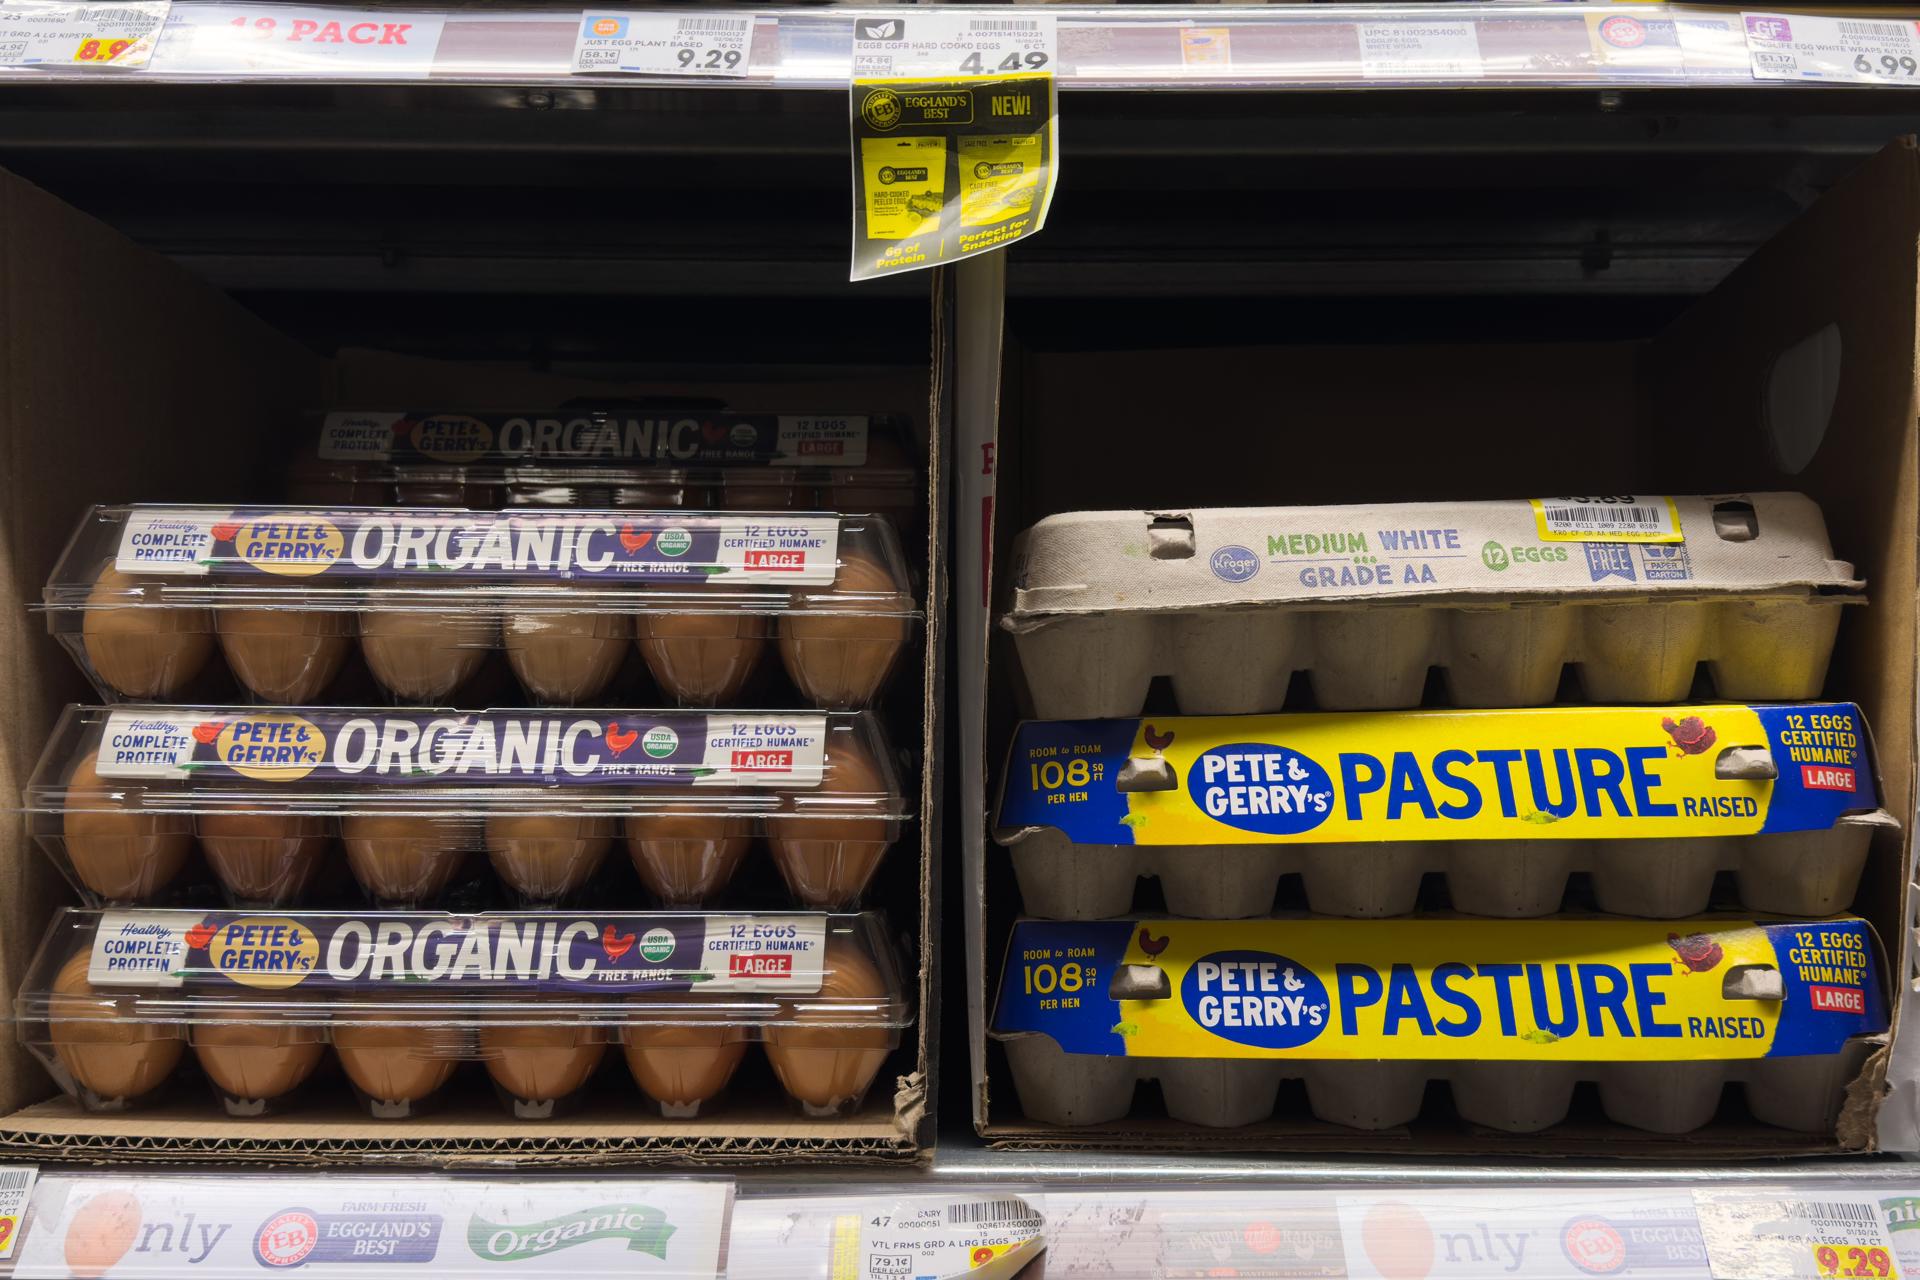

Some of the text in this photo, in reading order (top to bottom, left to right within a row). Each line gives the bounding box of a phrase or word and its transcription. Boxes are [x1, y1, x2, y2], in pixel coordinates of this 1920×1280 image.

[286, 19, 412, 45] PACK
[1755, 21, 1783, 36] GF
[1816, 44, 1845, 52] WHITE
[677, 49, 742, 69] 9.29
[958, 52, 1049, 74] 4.49
[1854, 54, 1917, 76] 6.99
[924, 108, 950, 119] BEST
[992, 95, 1031, 116] NEW!
[959, 218, 1030, 245] Perfect for
[961, 229, 1023, 252] Snacking
[885, 242, 920, 257] 6g of
[876, 253, 926, 269] Protein
[500, 418, 698, 459] ORGANIC
[250, 523, 329, 539] PETE &
[664, 532, 685, 541] USDA
[744, 525, 809, 537] 12 EGGS
[132, 533, 208, 547] COMPLETE
[351, 519, 618, 572] ORGANIC
[780, 539, 822, 549] HUMANE
[136, 548, 196, 561] PROTEIN
[1267, 529, 1630, 571] MEDIUM WHITE 12 EGGS FREE
[616, 563, 690, 573] FREE RANGE
[750, 554, 799, 568] LARGE
[1214, 553, 1256, 575] Kroger
[1299, 564, 1438, 588] GRADE AA
[1649, 571, 1683, 579] CARTON
[732, 724, 797, 736] 12 EGGS
[1786, 715, 1852, 731] 12 EGGS
[232, 722, 311, 742] PETE &
[650, 733, 672, 742] USDA
[1780, 730, 1856, 748] CERTIFIED
[112, 735, 188, 749] COMPLETE
[333, 718, 602, 776] ORGANIC
[711, 738, 809, 748] CERTIFIED HUMANE
[116, 751, 177, 765] PROTEIN
[1030, 744, 1102, 757] ROOM to ROAM
[1790, 747, 1851, 764] HUMANE
[738, 753, 787, 768] LARGE
[1203, 753, 1310, 783] PETE &
[601, 766, 675, 775] FREE RANGE
[1031, 759, 1104, 791] 108 SQ
[1093, 773, 1104, 781] FT
[1338, 746, 1678, 821] PASTURE
[1807, 770, 1852, 788] LARGE
[1047, 791, 1088, 805] PER HEN
[1683, 797, 1758, 817] RAISED
[121, 923, 173, 939] Healthy,
[225, 924, 304, 946] PETE &
[730, 924, 797, 938] 12 EGGS
[104, 940, 180, 955] COMPLETE
[647, 936, 669, 944] USDA
[709, 941, 809, 951] CERTIFIED HUMANE
[1795, 932, 1862, 950] 12 EGGS
[327, 920, 599, 981] ORGANIC
[1023, 948, 1095, 961] ROOM to ROAM
[1789, 948, 1866, 968] CERTIFIED
[108, 957, 170, 971] PROTEIN
[734, 959, 787, 975] LARGE
[598, 969, 673, 982] FREE RANGE
[1024, 962, 1097, 995] 108 SQ
[1086, 978, 1096, 987] FT
[1197, 962, 1305, 992] PETE &
[1799, 966, 1861, 985] HUMANE
[1040, 998, 1080, 1010] PER HEN
[1335, 962, 1683, 1038] PASTURE
[1816, 990, 1861, 1010] LARGE
[1688, 1016, 1765, 1039] RAISED
[871, 1216, 891, 1227] 47
[272, 1229, 305, 1250] EB
[487, 1207, 644, 1256] Organic
[353, 1240, 399, 1255] BEST
[872, 1241, 890, 1249] VTL
[893, 1241, 921, 1249] FRMS
[924, 1241, 945, 1249] GRD
[959, 1239, 979, 1247] LRG
[982, 1237, 1009, 1246] EGGS
[1821, 1236, 1849, 1245] EGGS
[1869, 1238, 1882, 1246] CT
[875, 1257, 908, 1267] 79.1¢
[1817, 1246, 1890, 1276] 9.29
